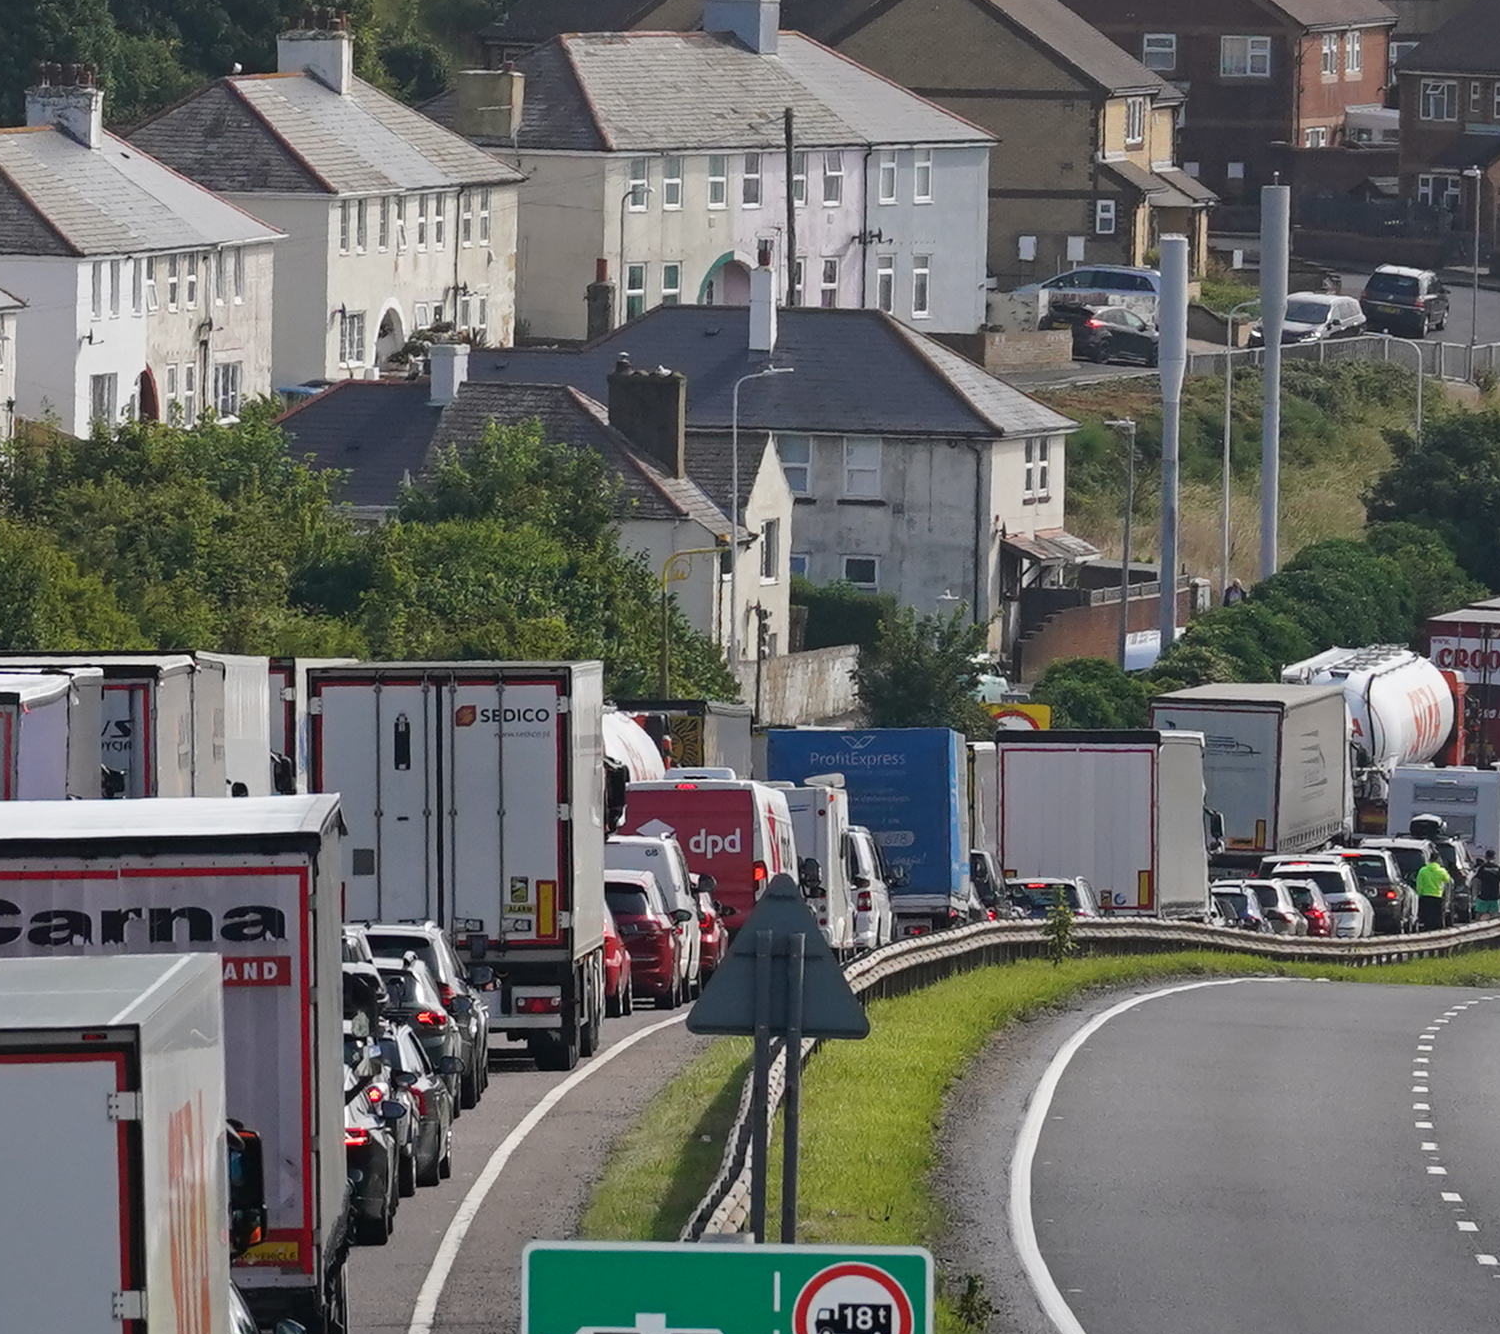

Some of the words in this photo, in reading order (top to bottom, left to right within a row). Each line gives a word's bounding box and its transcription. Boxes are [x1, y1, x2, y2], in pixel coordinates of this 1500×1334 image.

[480, 709, 550, 723] SEDICO
[810, 751, 906, 767] ProfitExpress
[689, 828, 741, 859] dpd
[223, 962, 278, 981] AND
